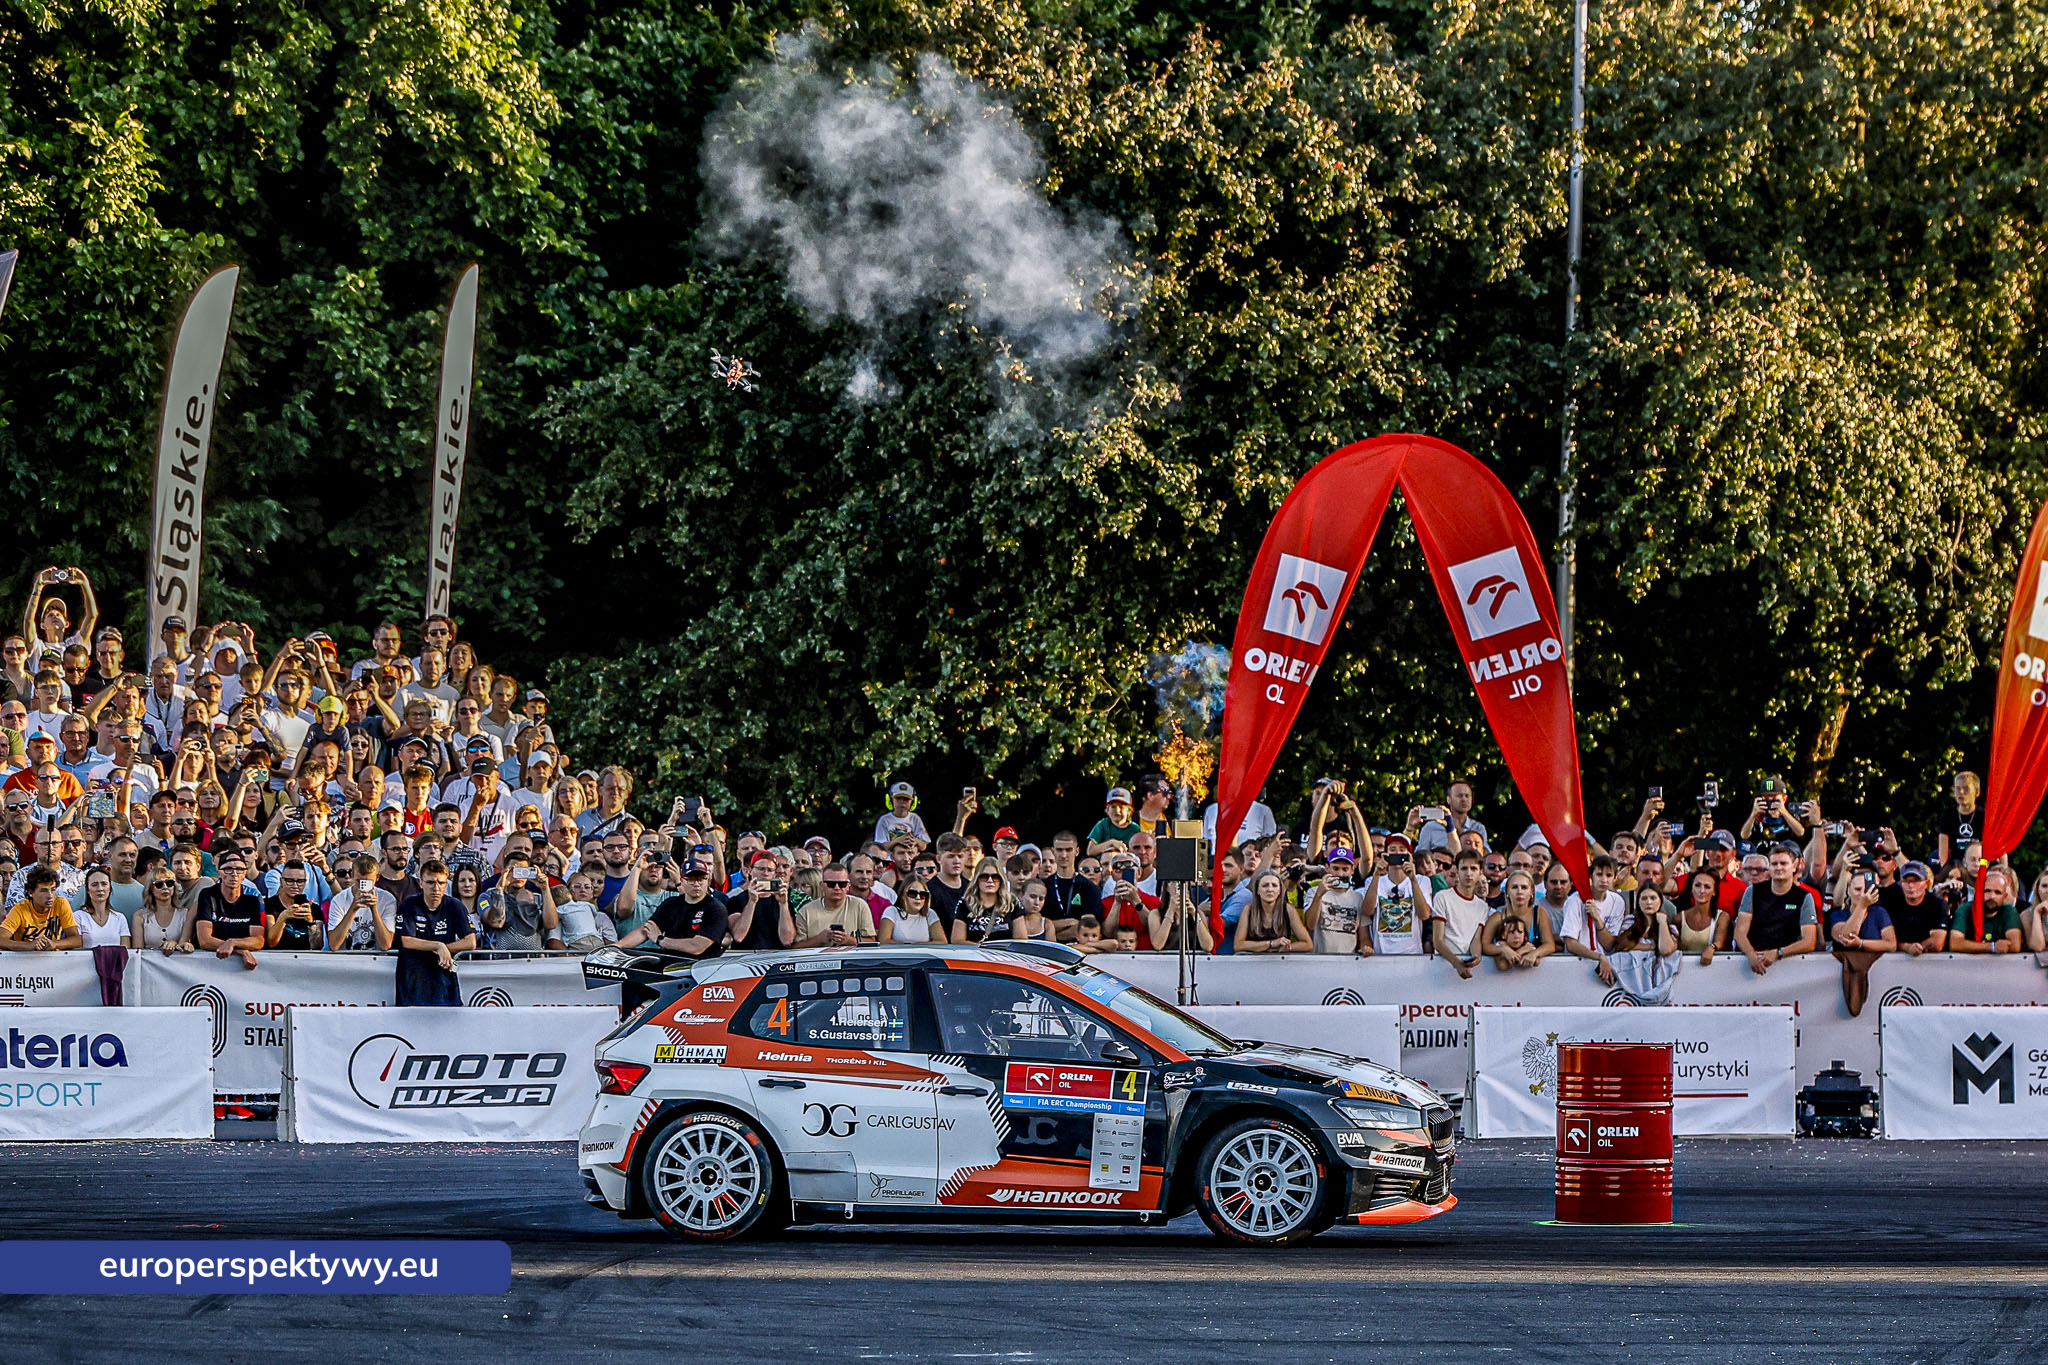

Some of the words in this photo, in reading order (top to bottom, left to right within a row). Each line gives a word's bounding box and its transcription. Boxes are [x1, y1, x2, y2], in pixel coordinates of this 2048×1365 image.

[156, 383, 209, 613] Śląskie.
[2013, 652, 2048, 684] OR
[779, 964, 795, 972] CAR
[15, 973, 54, 993] ŚLĄSKI
[767, 998, 791, 1036] 4
[809, 1029, 887, 1041] S.Gustavsson
[757, 1051, 813, 1063] Helmia
[399, 1053, 567, 1081] MOTO
[1058, 1072, 1093, 1082] ORLEN
[1058, 1081, 1072, 1089] OIL
[1121, 1071, 1137, 1101] 4
[394, 1087, 551, 1106] WIZJA
[1037, 1098, 1049, 1106] FIA
[1051, 1099, 1064, 1107] ERC
[1065, 1099, 1112, 1111] Championship
[1597, 1126, 1640, 1137] ORLEN
[1597, 1139, 1613, 1148] OIL
[882, 1189, 926, 1197] PROFILLAGET
